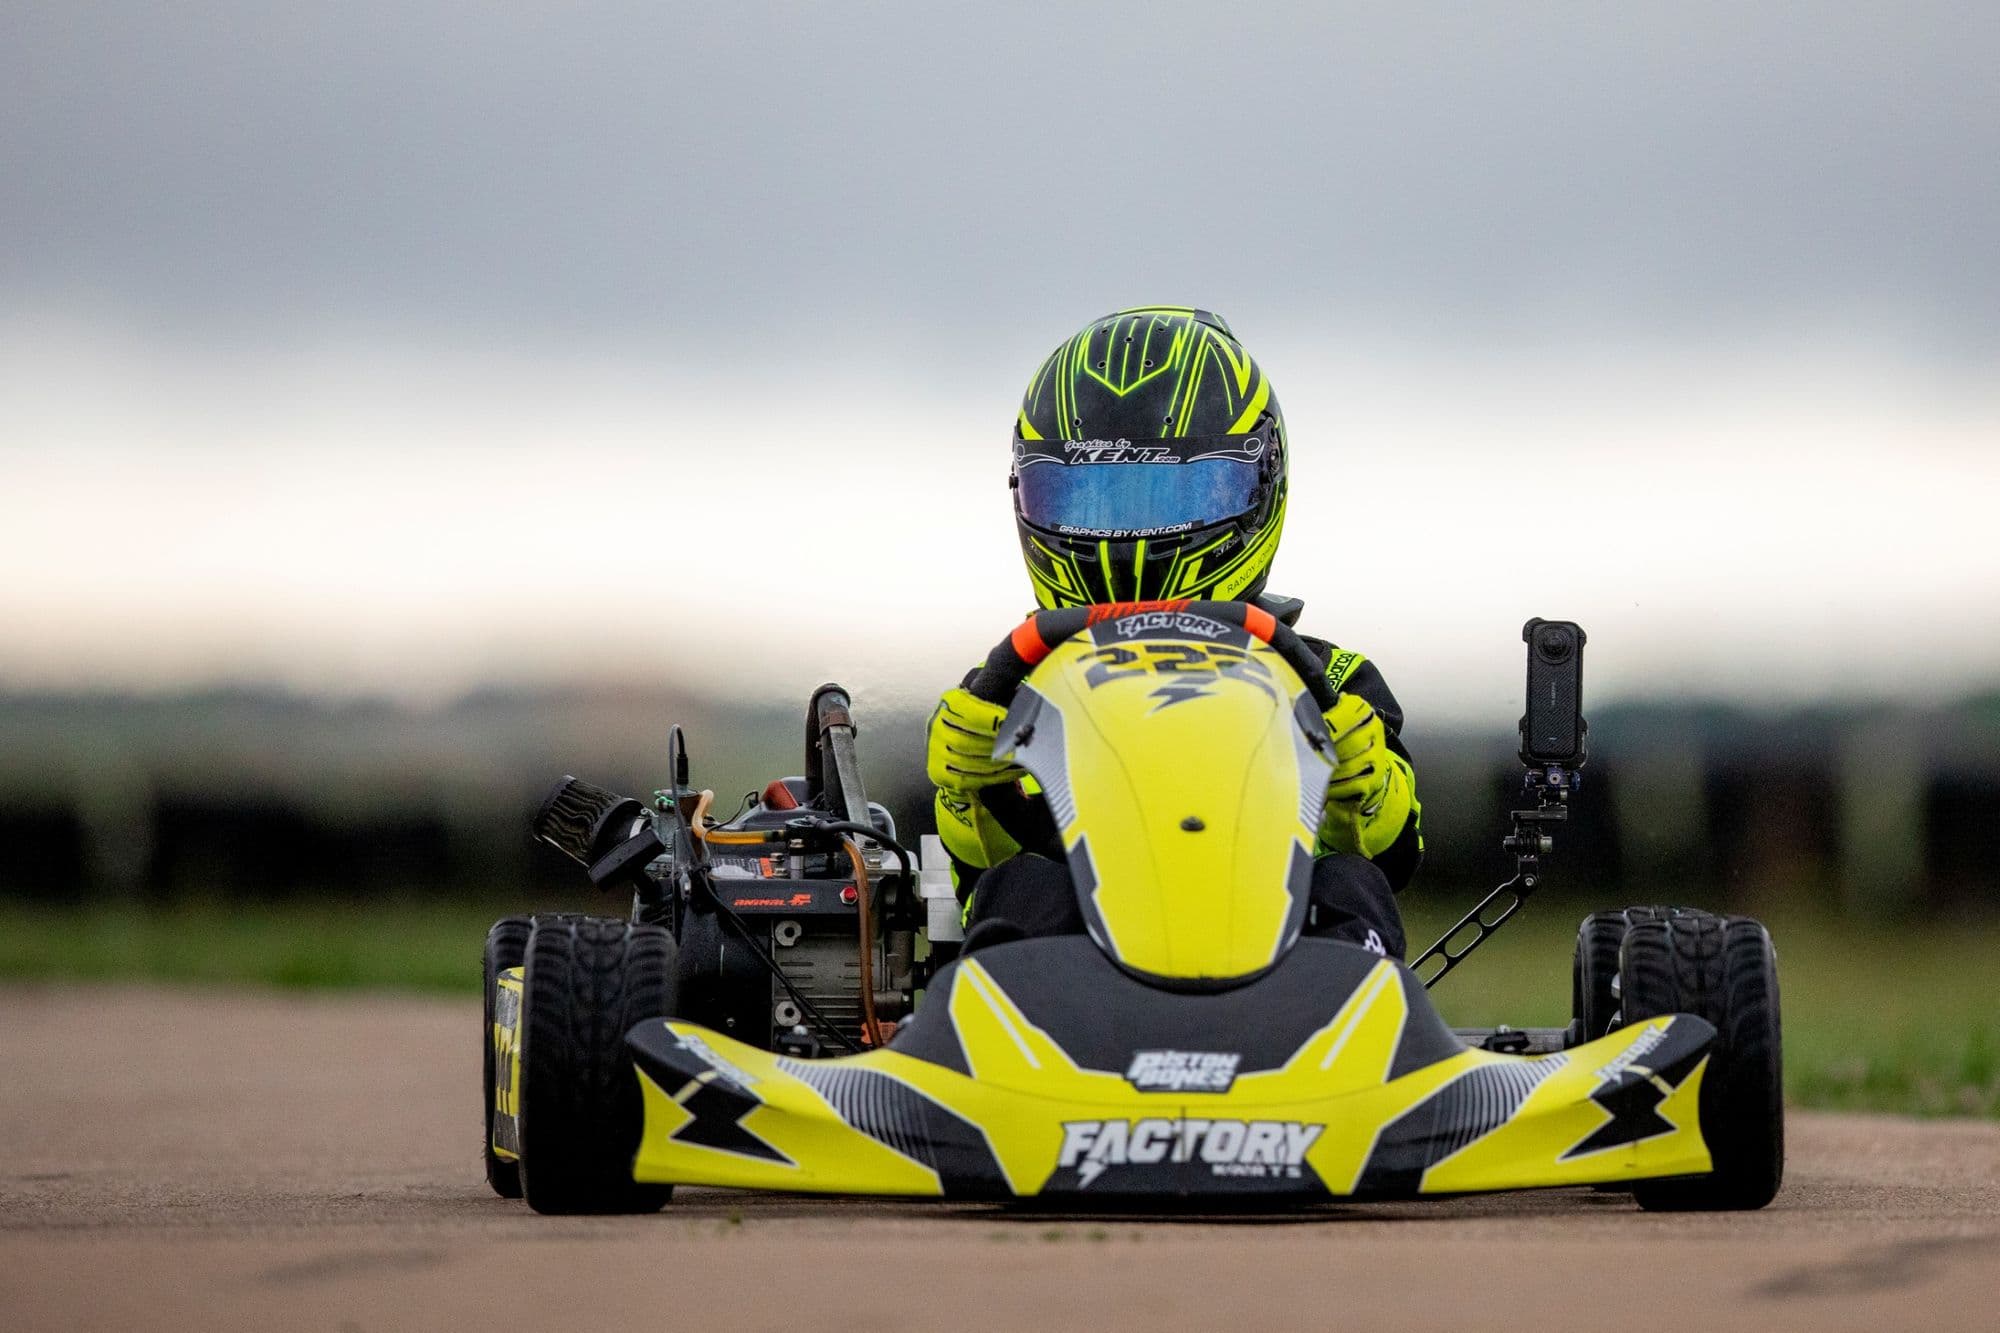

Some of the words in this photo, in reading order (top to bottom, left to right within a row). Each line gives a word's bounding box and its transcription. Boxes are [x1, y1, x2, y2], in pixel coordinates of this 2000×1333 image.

[1059, 525, 1112, 537] GRAPHICS
[1113, 529, 1130, 537] BY
[1131, 522, 1192, 536] KENT.COM
[1115, 612, 1231, 638] FACTORY
[1058, 1118, 1327, 1169] FACTORY
